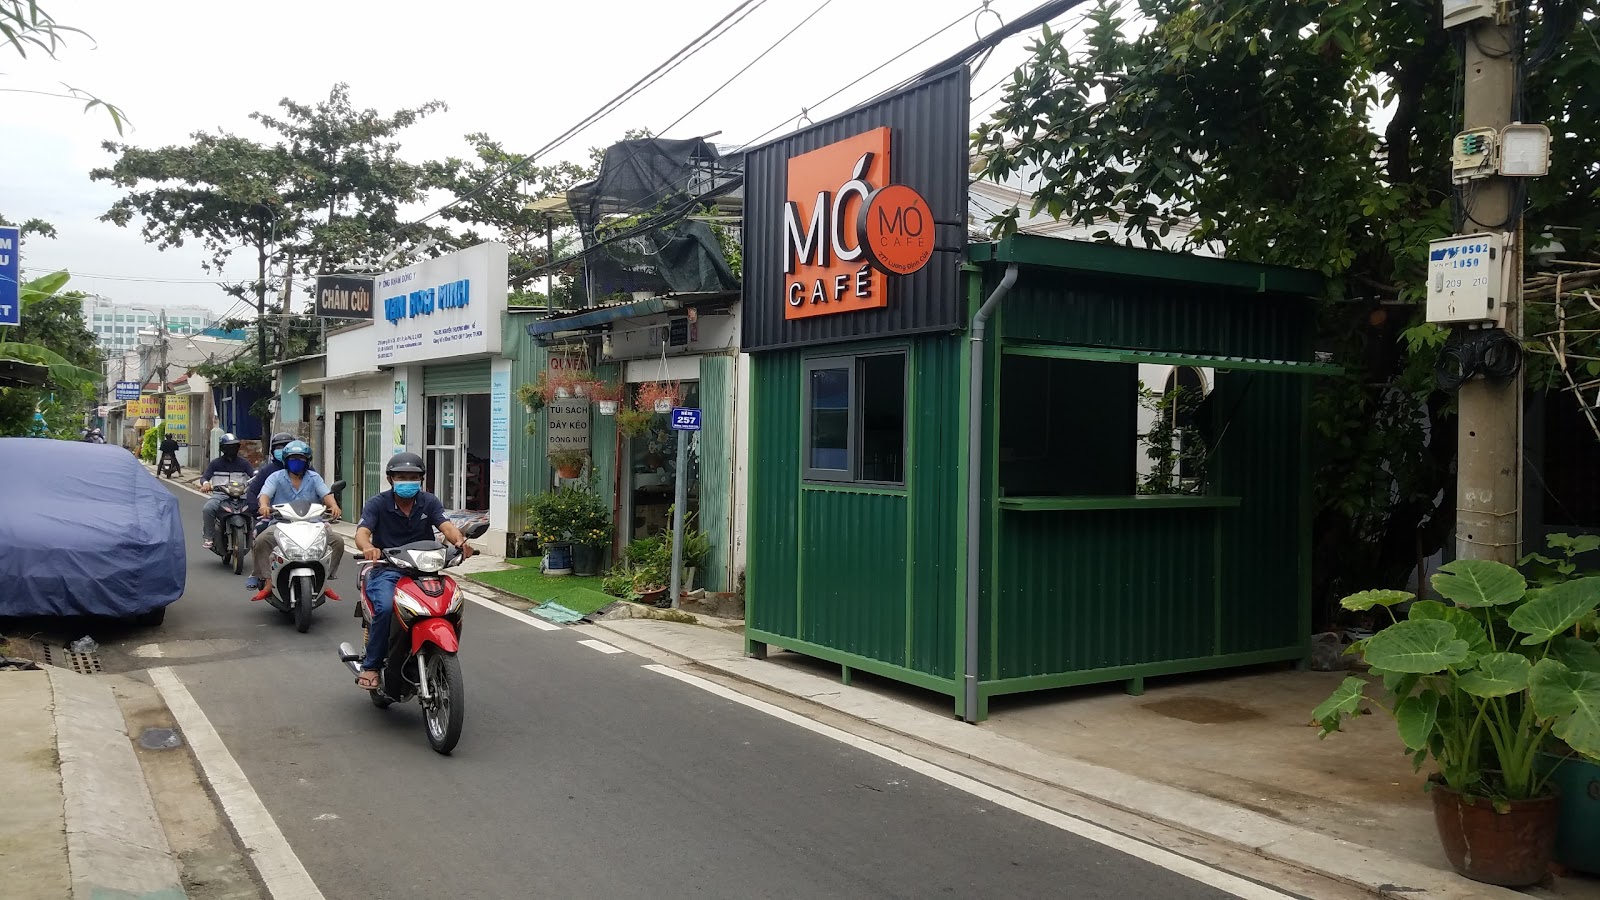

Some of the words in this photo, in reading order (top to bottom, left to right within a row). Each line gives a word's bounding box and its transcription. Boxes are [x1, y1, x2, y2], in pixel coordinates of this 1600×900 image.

[1453, 258, 1479, 269] 1050
[789, 263, 872, 307] CAFÉ
[1446, 279, 1462, 288] 209
[1472, 276, 1488, 287] 210
[321, 284, 349, 311] CHÂM
[350, 286, 370, 312] CỨU
[0, 304, 12, 316] T
[550, 405, 563, 414] TÚI
[550, 419, 567, 429] DÂY
[569, 420, 587, 429] KÉO
[676, 416, 697, 424] 257
[572, 435, 587, 443] NÚT
